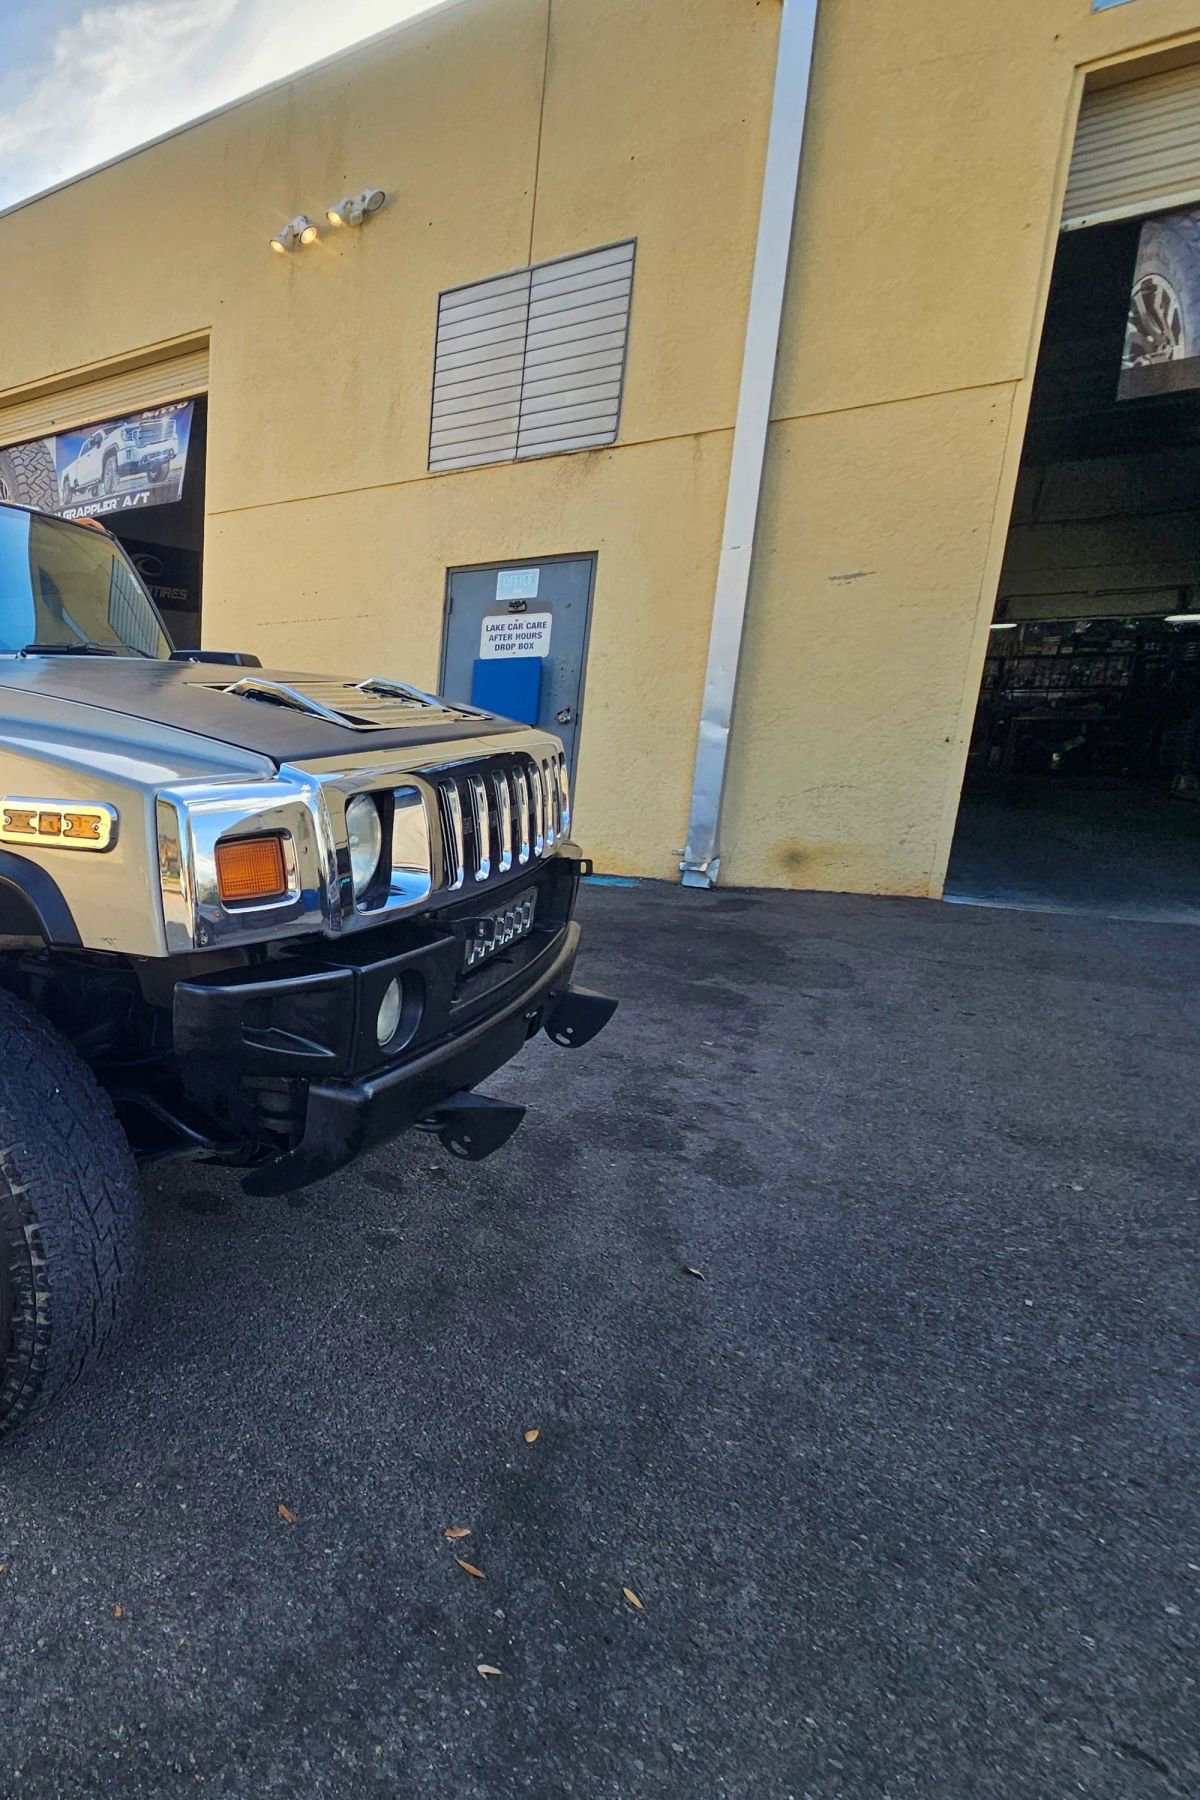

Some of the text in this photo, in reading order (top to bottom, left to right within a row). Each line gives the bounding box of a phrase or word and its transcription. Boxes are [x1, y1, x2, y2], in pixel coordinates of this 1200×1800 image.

[122, 491, 150, 508] A/T
[502, 574, 533, 587] OFFICE
[486, 621, 547, 632] LAKE CAR CARE
[488, 631, 543, 642] AFTER HOURS
[494, 642, 535, 652] DROP BOX
